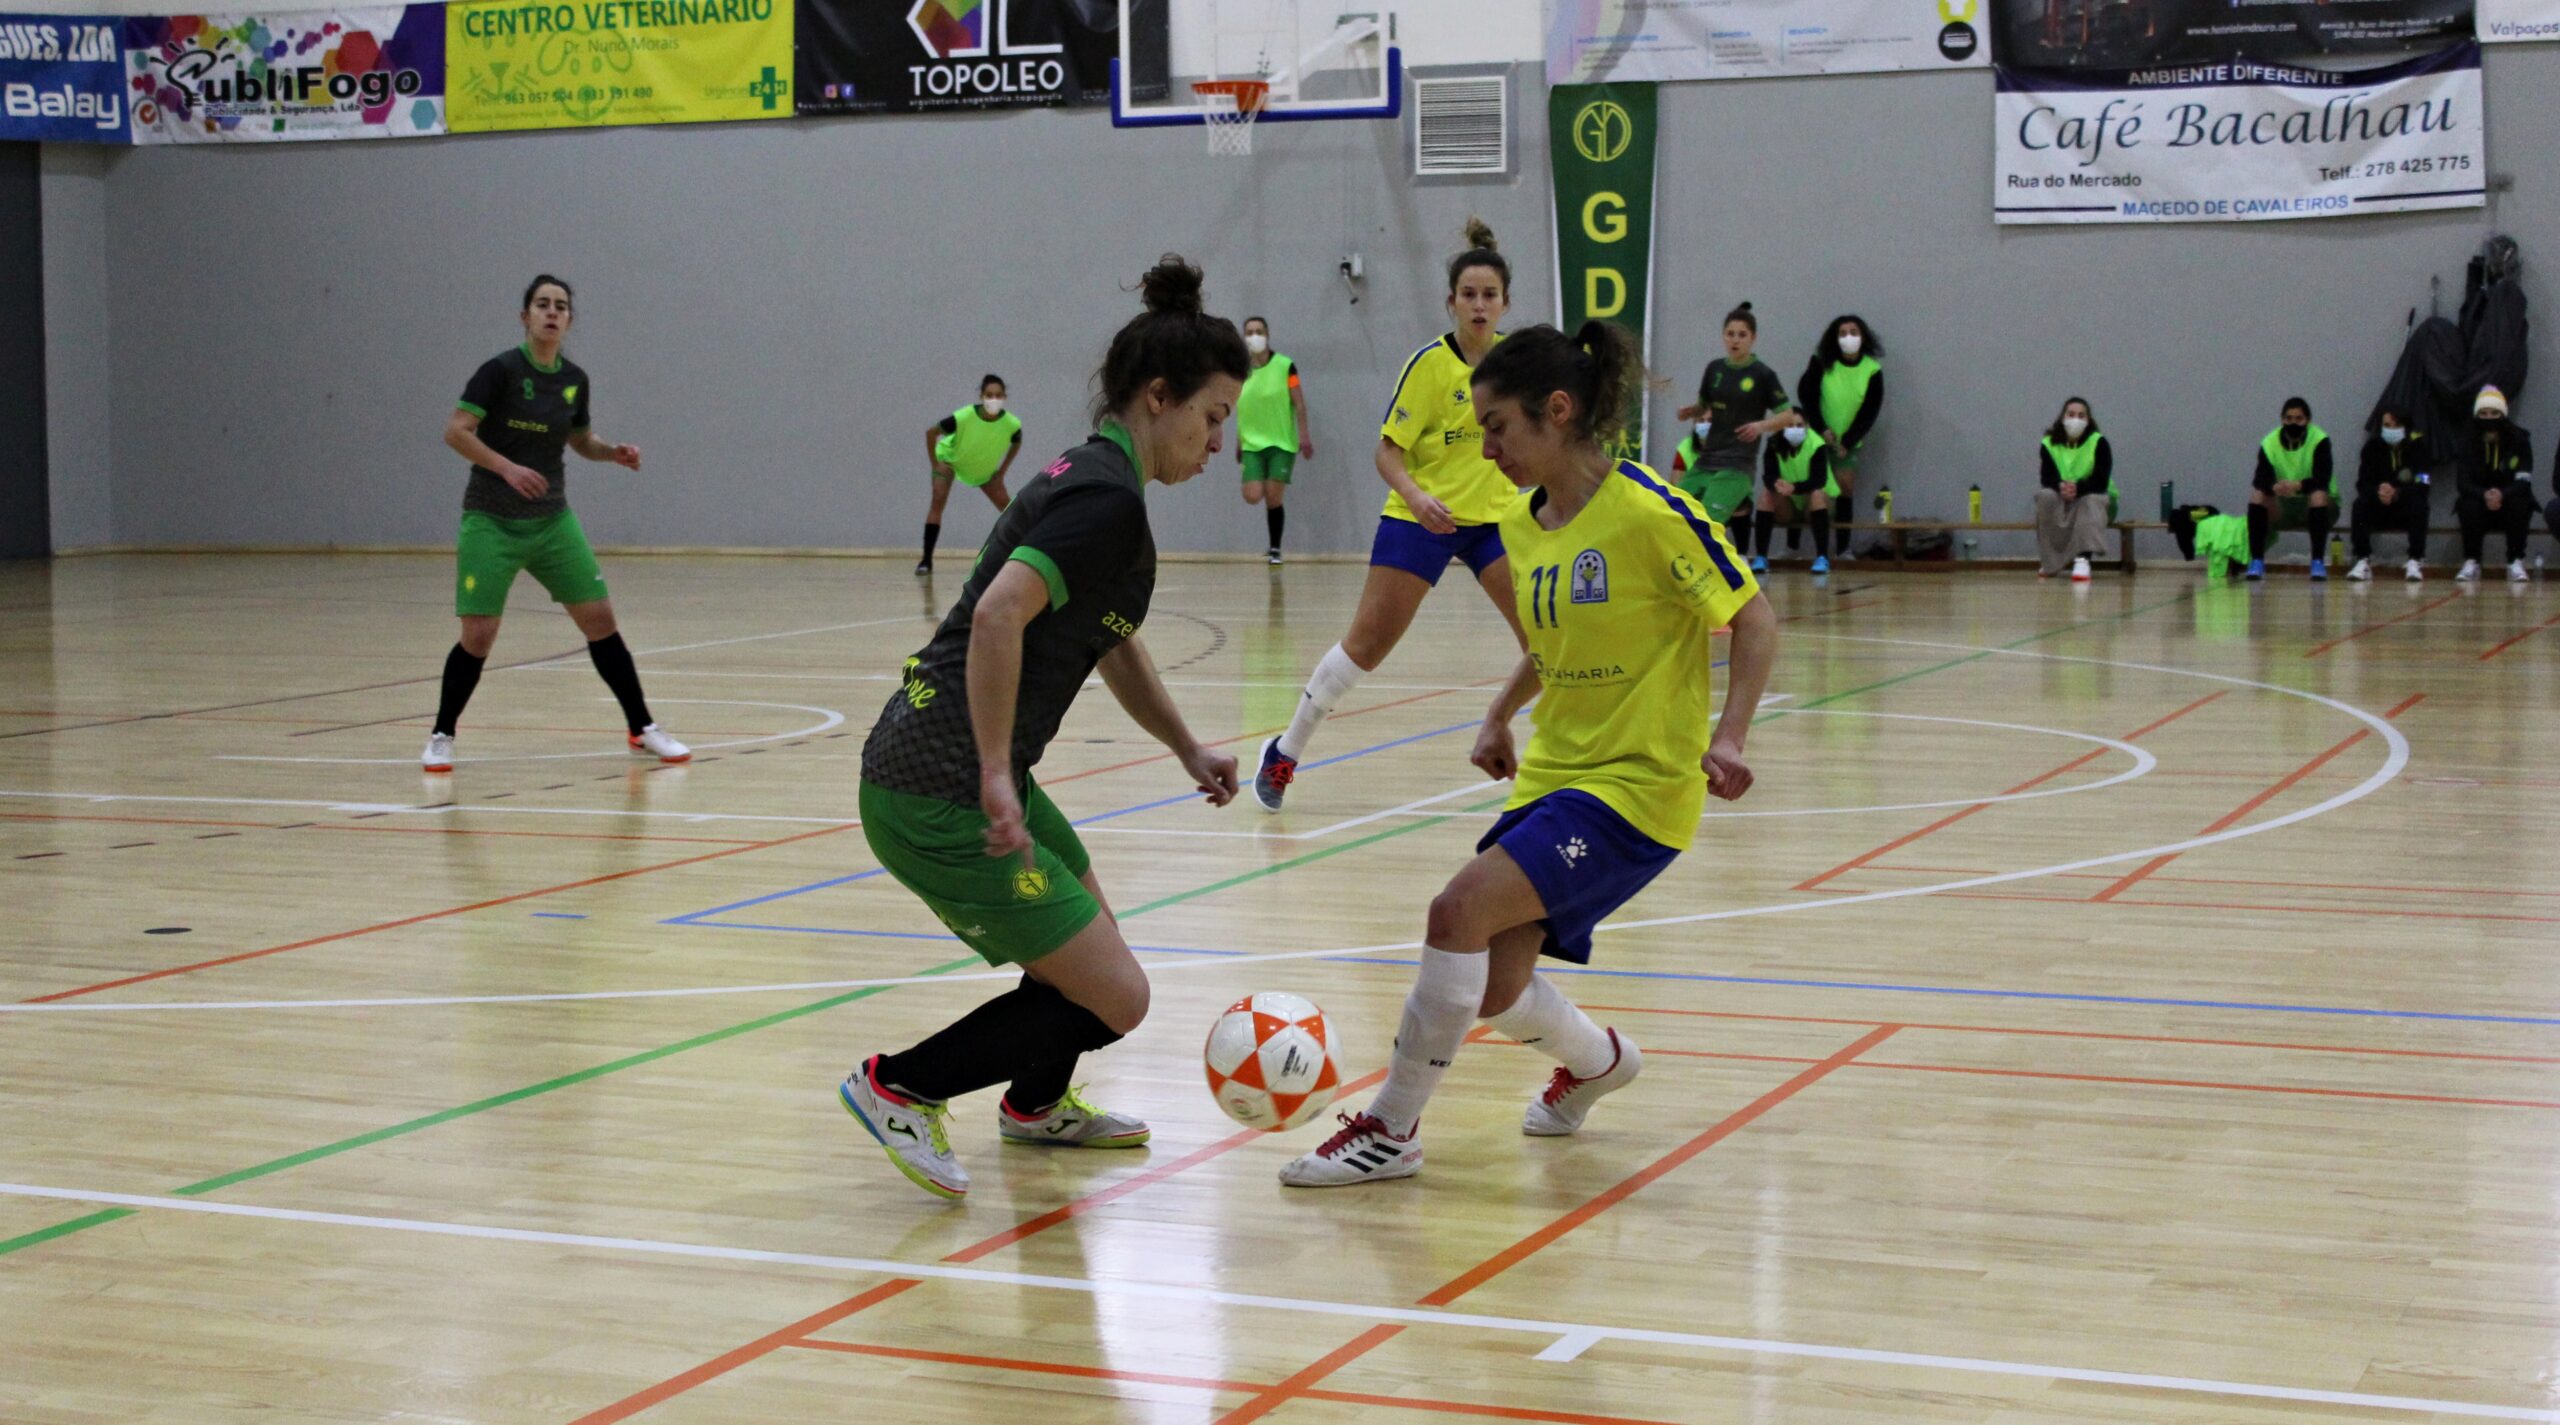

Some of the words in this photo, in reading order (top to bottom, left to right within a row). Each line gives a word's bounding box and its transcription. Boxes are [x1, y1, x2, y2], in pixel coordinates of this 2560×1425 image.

[465, 5, 575, 37] CENTRO
[2490, 22, 2559, 37] Valpaços
[67, 25, 117, 62] LDA
[908, 60, 1064, 96] TOPOLEO
[2128, 65, 2229, 85] AMBIENTE
[2233, 64, 2344, 85] DIFERENTE
[5, 83, 120, 130] Balay
[204, 105, 266, 117] Publicidade
[270, 104, 277, 115] &
[2018, 98, 2144, 167] Café
[2166, 92, 2457, 148] Bacalhau
[2007, 175, 2040, 188] Rua
[2044, 174, 2065, 188] do
[2070, 173, 2142, 188] Mercado
[2365, 161, 2396, 177] 278
[2400, 158, 2433, 173] 425
[2438, 155, 2471, 171] 775
[1582, 191, 1628, 244] G
[2123, 201, 2199, 216] MACEDO
[2204, 199, 2228, 215] DE
[2233, 195, 2349, 215] CAVALEIROS
[1585, 267, 1627, 318] D
[1530, 564, 1560, 630] 11
